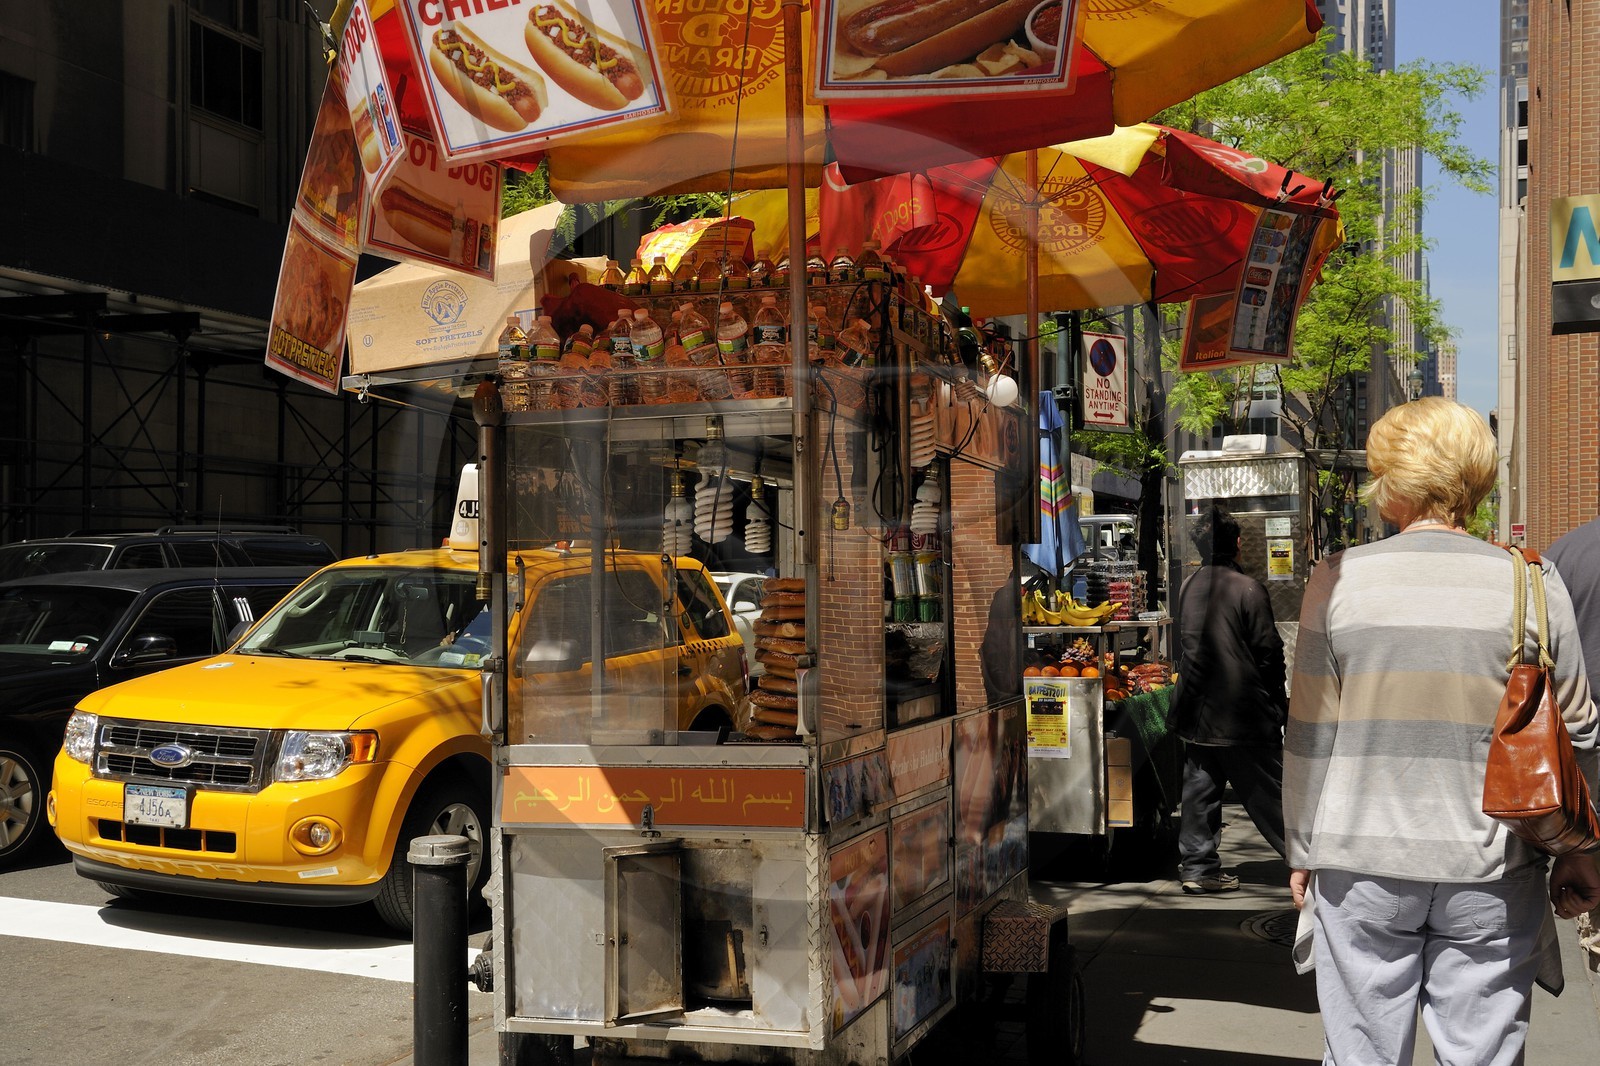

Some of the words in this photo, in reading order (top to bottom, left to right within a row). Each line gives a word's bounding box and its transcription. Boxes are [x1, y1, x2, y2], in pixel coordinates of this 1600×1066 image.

[883, 197, 922, 233] Dogs
[444, 282, 466, 299] Pretzels
[416, 336, 438, 346] SOFT
[439, 329, 483, 343] PRETZELS
[271, 326, 292, 356] HOT
[289, 335, 338, 381] PRETZELS
[1195, 349, 1225, 361] Italian
[1097, 377, 1111, 389] NO
[1085, 388, 1122, 402] STANDING
[1088, 400, 1119, 412] ANYTIME
[156, 749, 176, 761] Ford
[512, 776, 591, 814] الرحيم
[596, 777, 684, 813] الرحمن
[691, 777, 735, 803] الله
[741, 790, 793, 816] بسم
